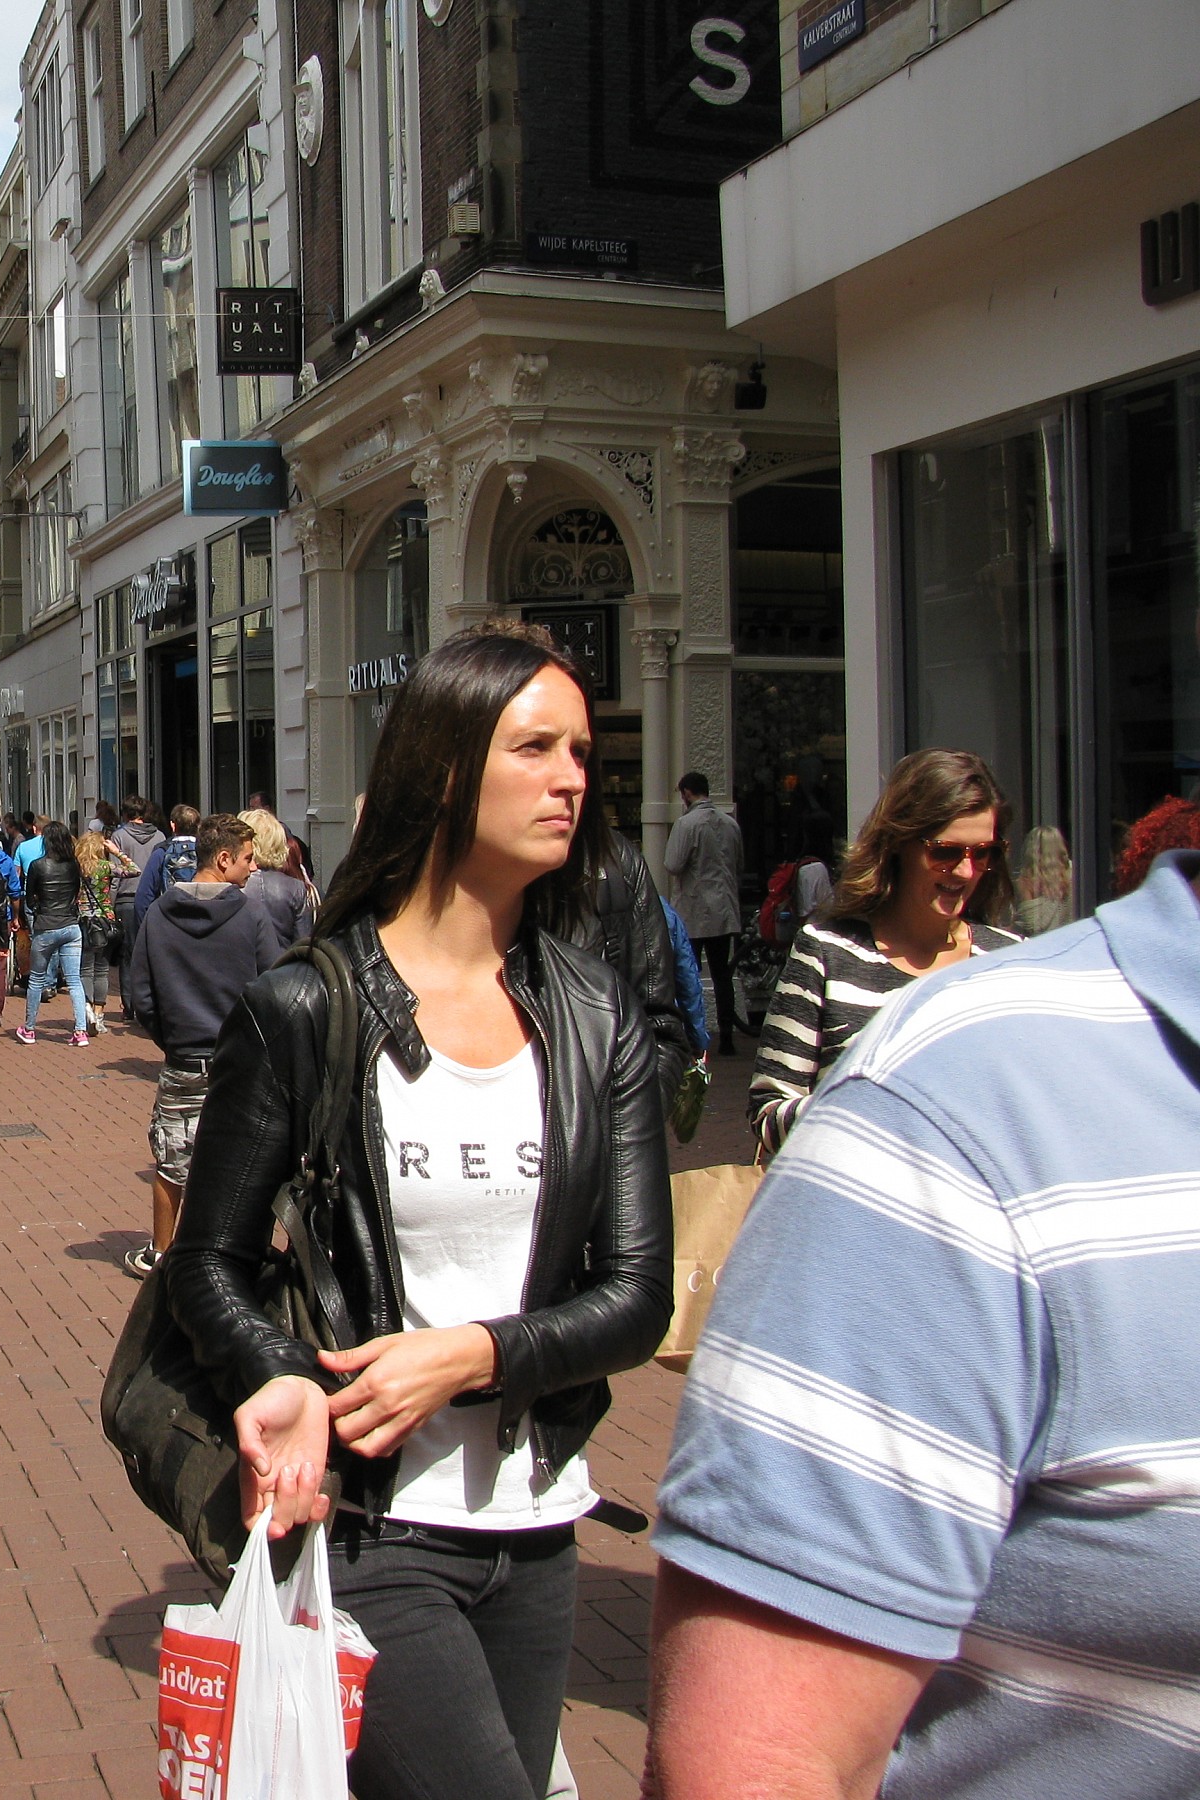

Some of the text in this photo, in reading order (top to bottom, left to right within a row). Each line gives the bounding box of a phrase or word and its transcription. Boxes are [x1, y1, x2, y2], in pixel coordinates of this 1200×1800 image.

[803, 0, 856, 50] KALVERSTRAAT
[833, 21, 857, 45] CENTRUM
[688, 17, 752, 106] S
[538, 236, 628, 254] WIJDE KAPELSTEEG
[597, 255, 628, 264] CENTRUM
[197, 463, 275, 493] Douglas
[159, 1661, 226, 1700] uidvat
